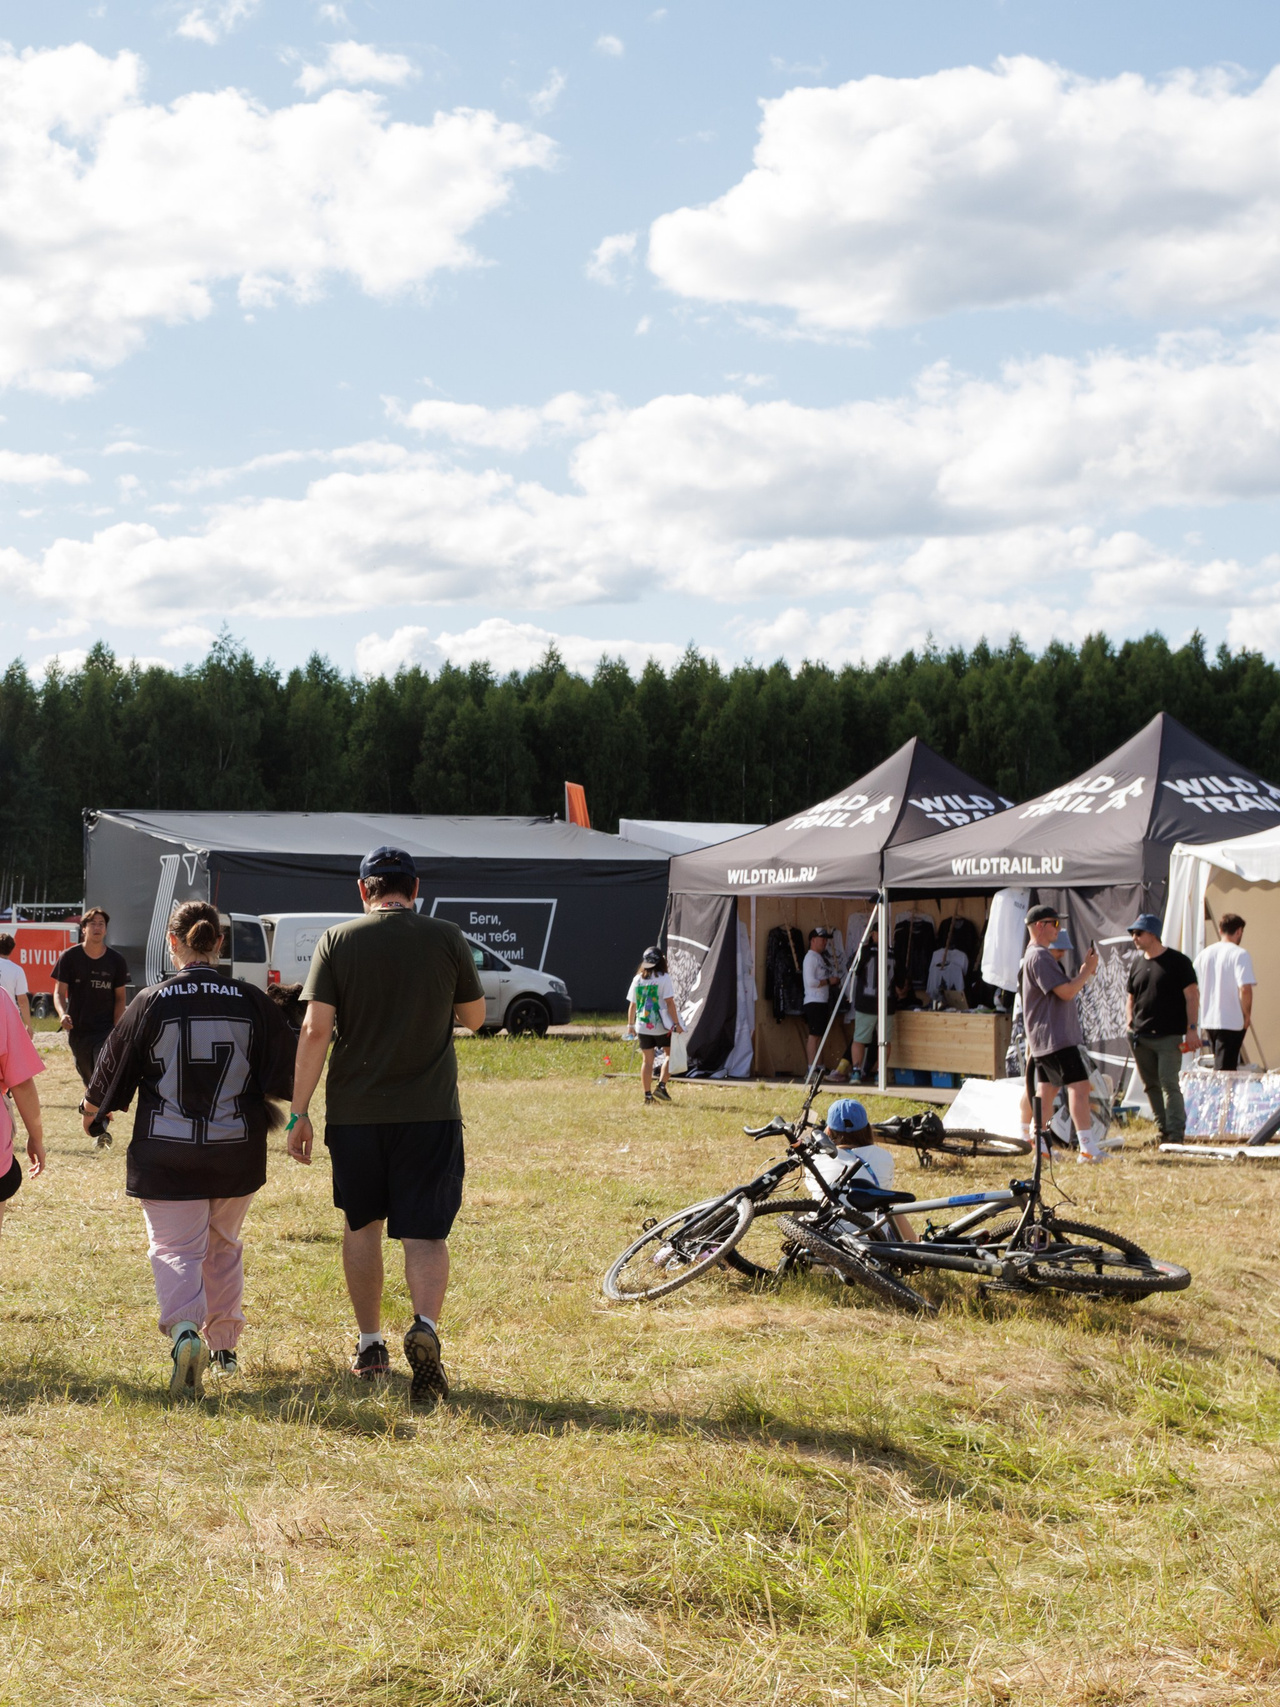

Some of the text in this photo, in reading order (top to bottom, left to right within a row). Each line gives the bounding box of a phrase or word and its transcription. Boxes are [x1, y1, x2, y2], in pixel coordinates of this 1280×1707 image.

[1162, 776, 1259, 796] WILD
[908, 794, 995, 812] WILD
[1018, 795, 1096, 819] TRAIL
[785, 811, 851, 831] TRAIL
[727, 866, 818, 884] WILDTRAIL.RU
[951, 857, 1063, 875] WILDTRAIL.RU
[469, 911, 502, 926] Беги,
[489, 929, 517, 942] тебя
[90, 980, 112, 989] TEAM
[160, 982, 243, 998] WILD TRAIL
[148, 1015, 255, 1145] 17
